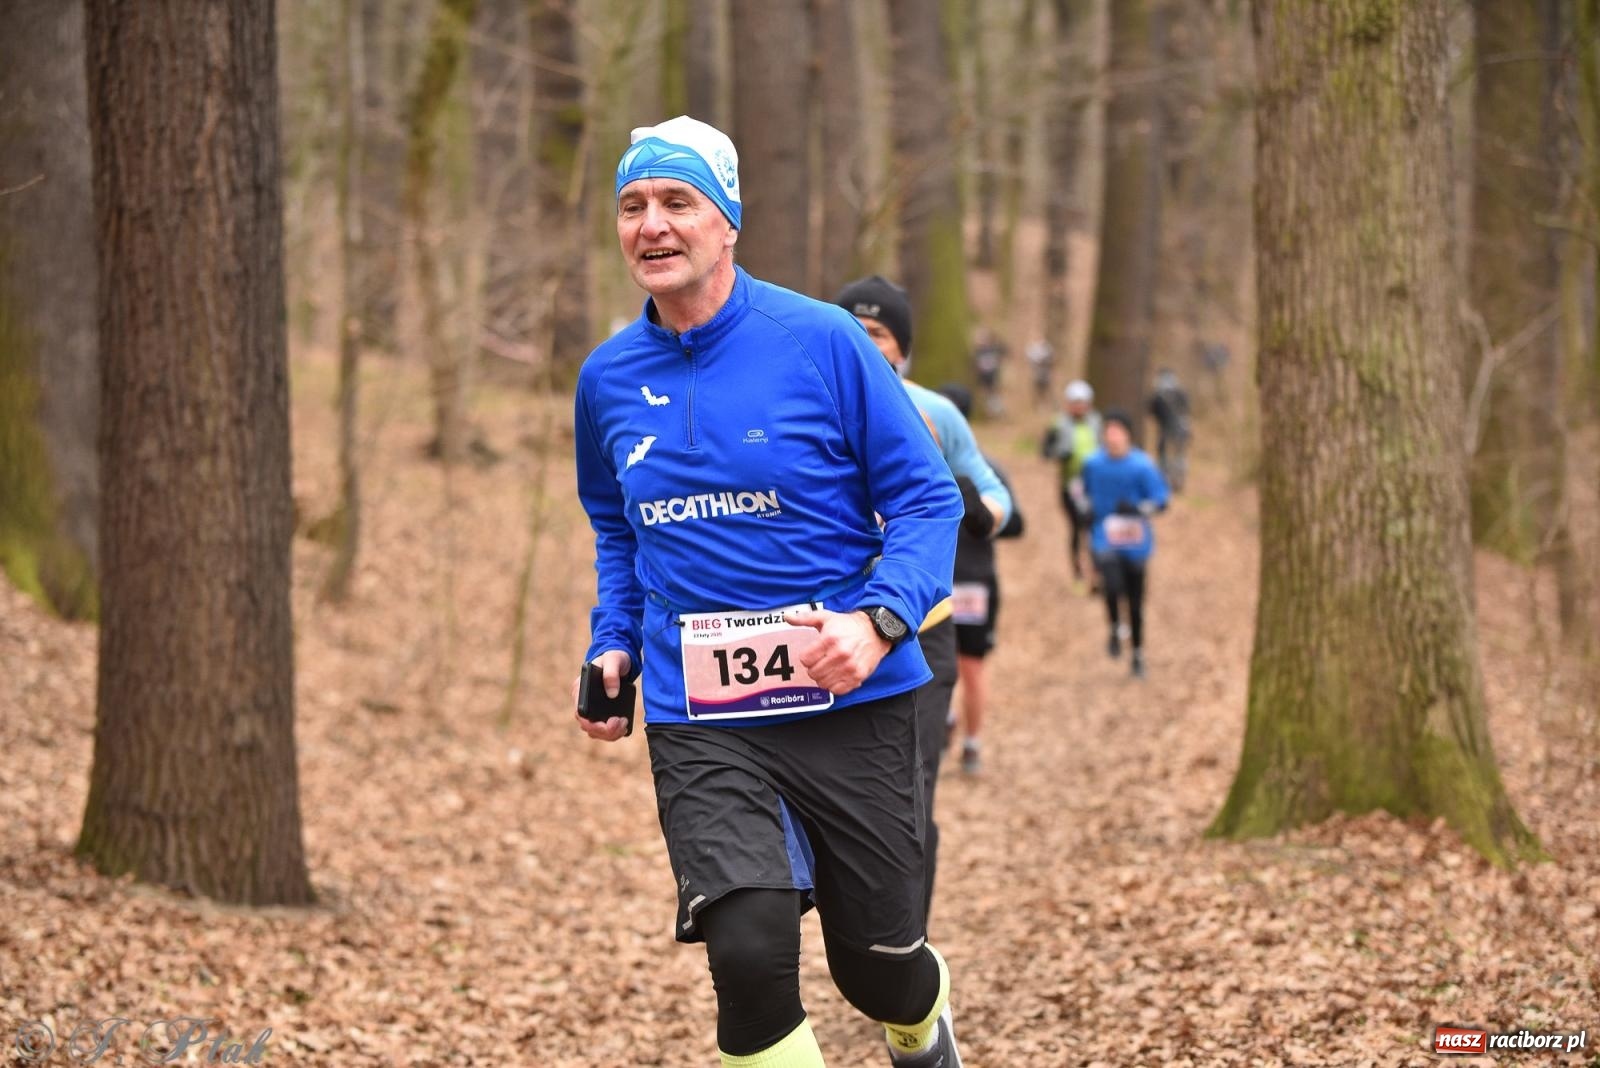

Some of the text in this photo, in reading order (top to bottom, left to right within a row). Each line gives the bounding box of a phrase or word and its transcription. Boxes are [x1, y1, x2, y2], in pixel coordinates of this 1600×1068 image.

[638, 489, 780, 526] DECATHLON
[692, 618, 722, 631] BIEG
[713, 644, 795, 687] 134
[771, 694, 805, 705] Racibórz
